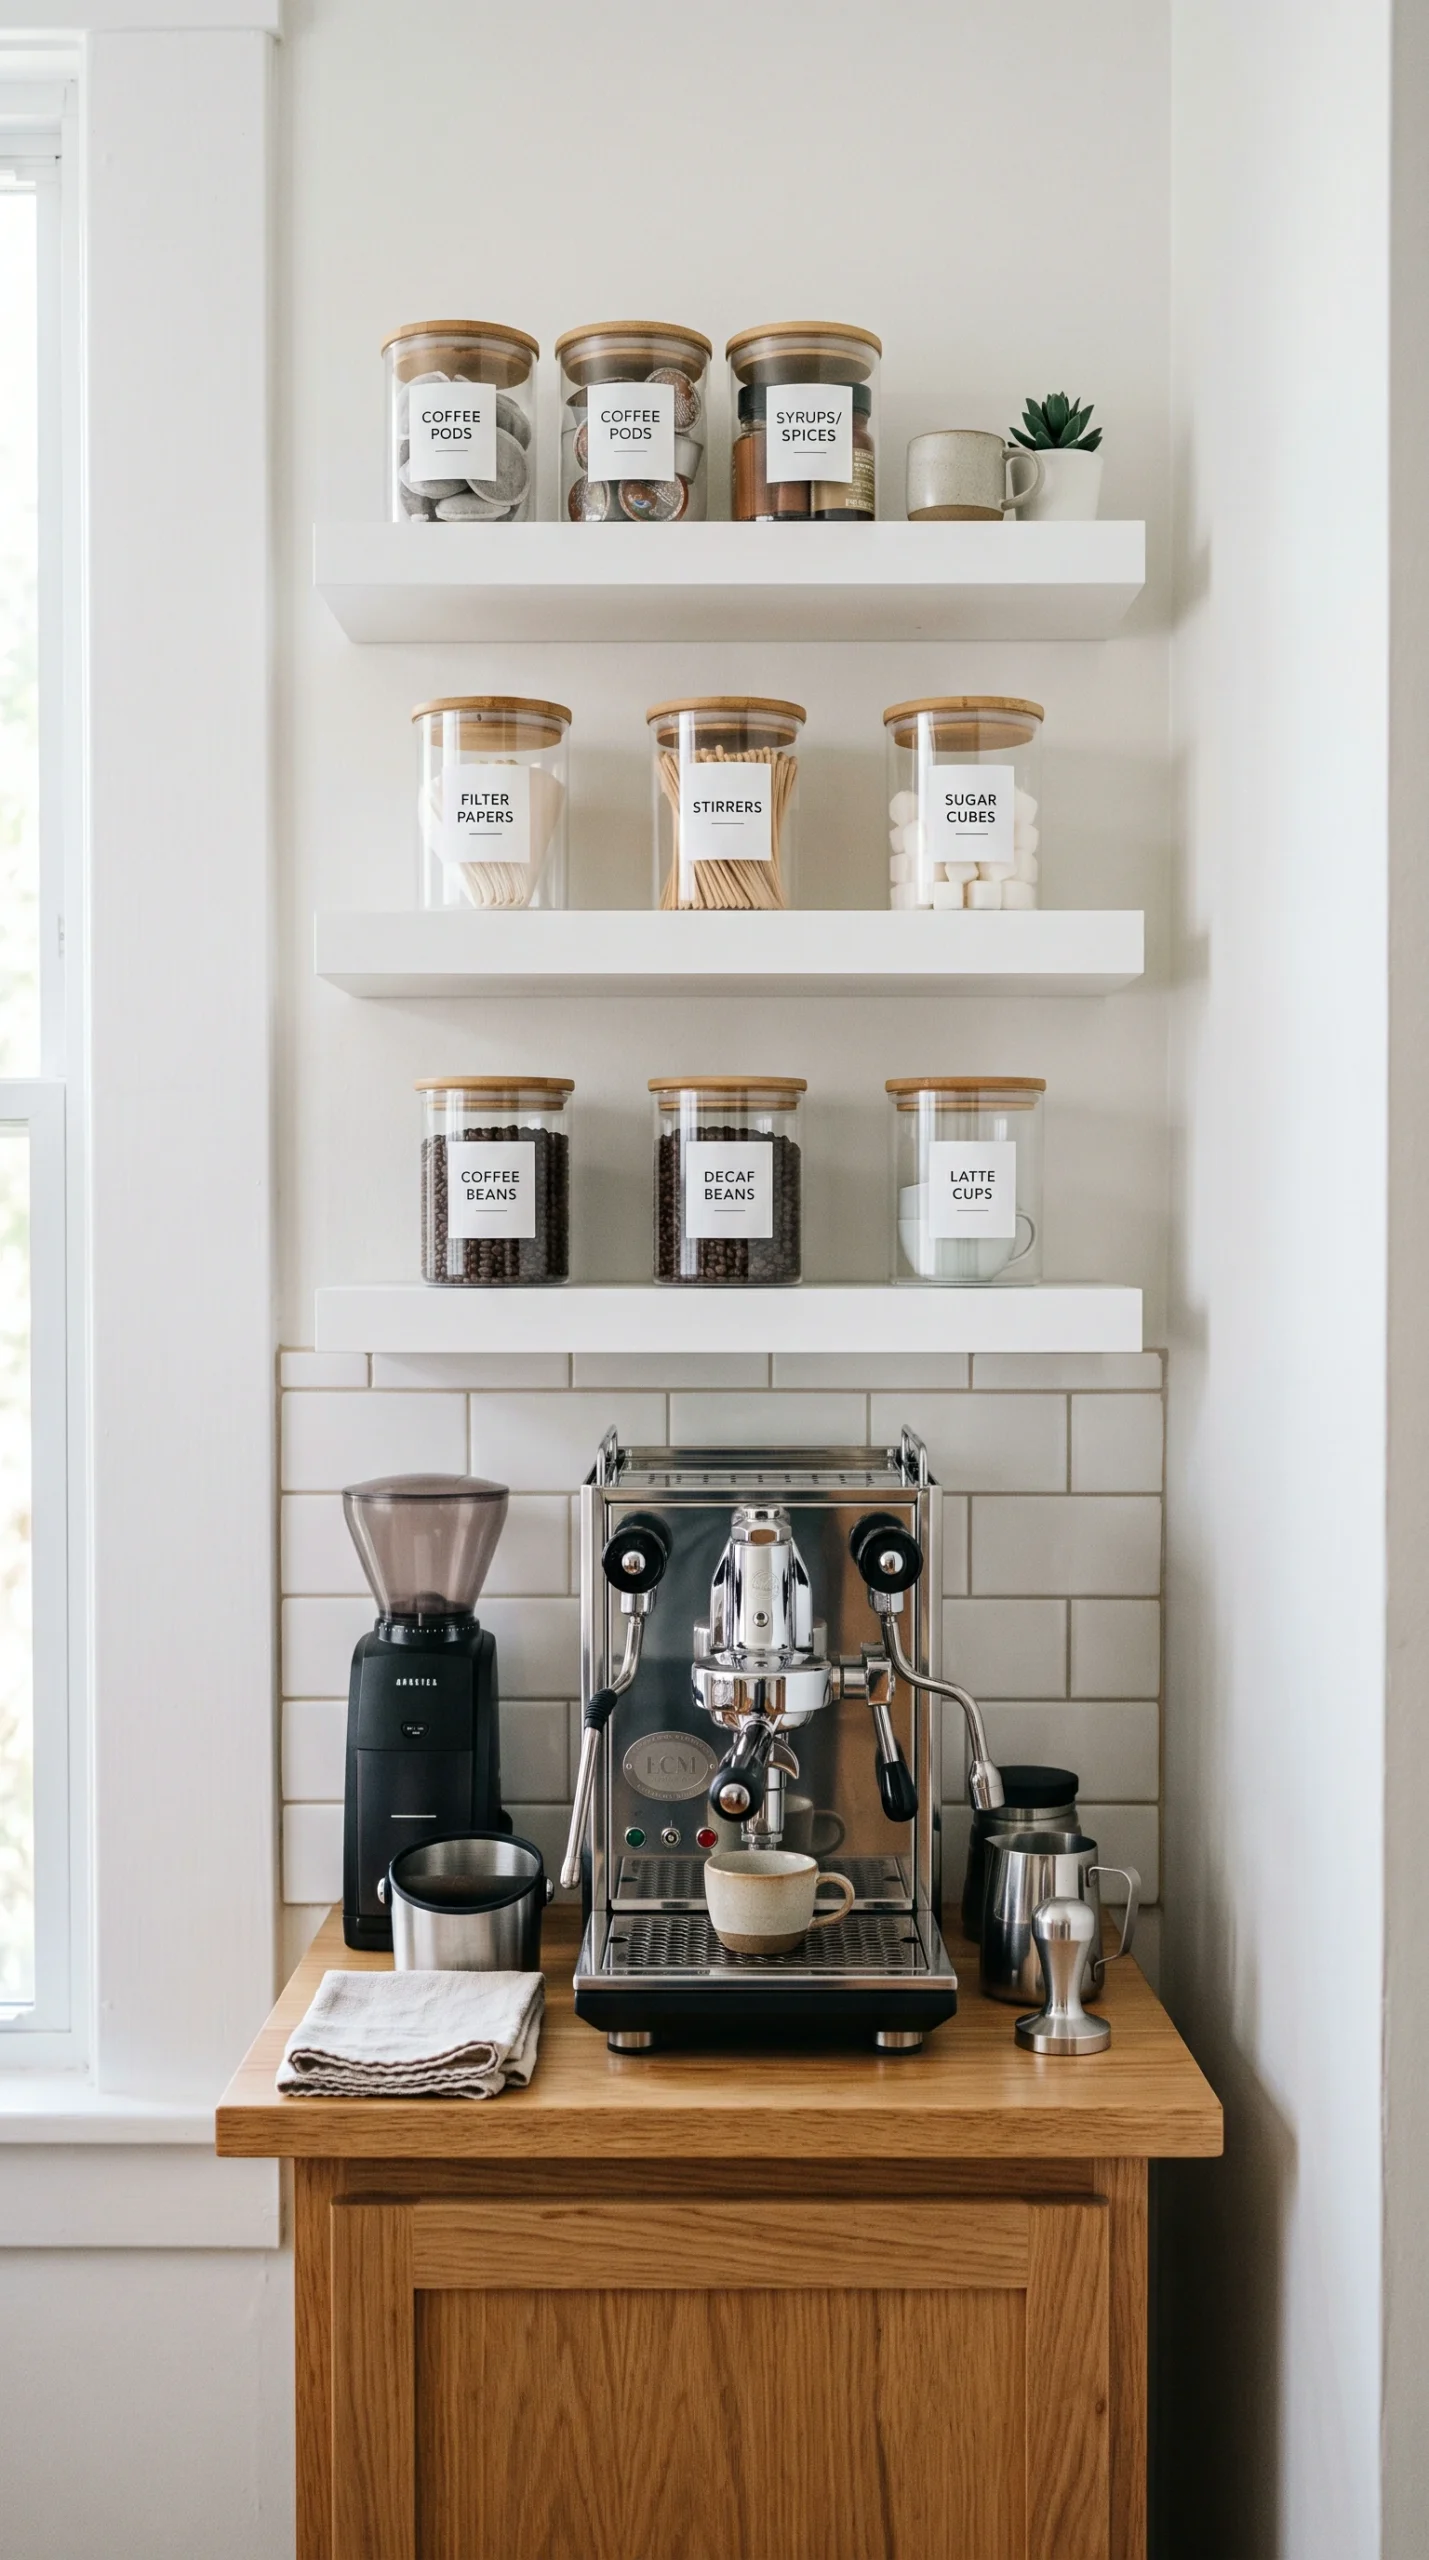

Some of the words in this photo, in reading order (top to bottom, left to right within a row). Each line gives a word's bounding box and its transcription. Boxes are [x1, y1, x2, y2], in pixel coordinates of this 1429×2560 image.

[422, 410, 480, 424] COFFEE
[601, 409, 661, 423] COFFEE
[777, 411, 843, 425] SYRUPS/
[432, 427, 472, 440] PODS
[609, 427, 652, 440] PODS
[782, 428, 837, 442] SPICES
[461, 793, 510, 806] FILTER
[945, 793, 997, 806] SUGAR
[693, 800, 762, 814] STIRRERS
[457, 810, 514, 823] PAPERS
[946, 810, 996, 824] CUBES
[461, 1170, 520, 1184] COFFEE
[704, 1170, 755, 1183] DECAF
[950, 1170, 996, 1183] LATTE
[466, 1187, 517, 1201] BEANS
[704, 1188, 755, 1201] BEANS
[952, 1187, 993, 1200] CUPS
[646, 1756, 697, 1775] ECM
